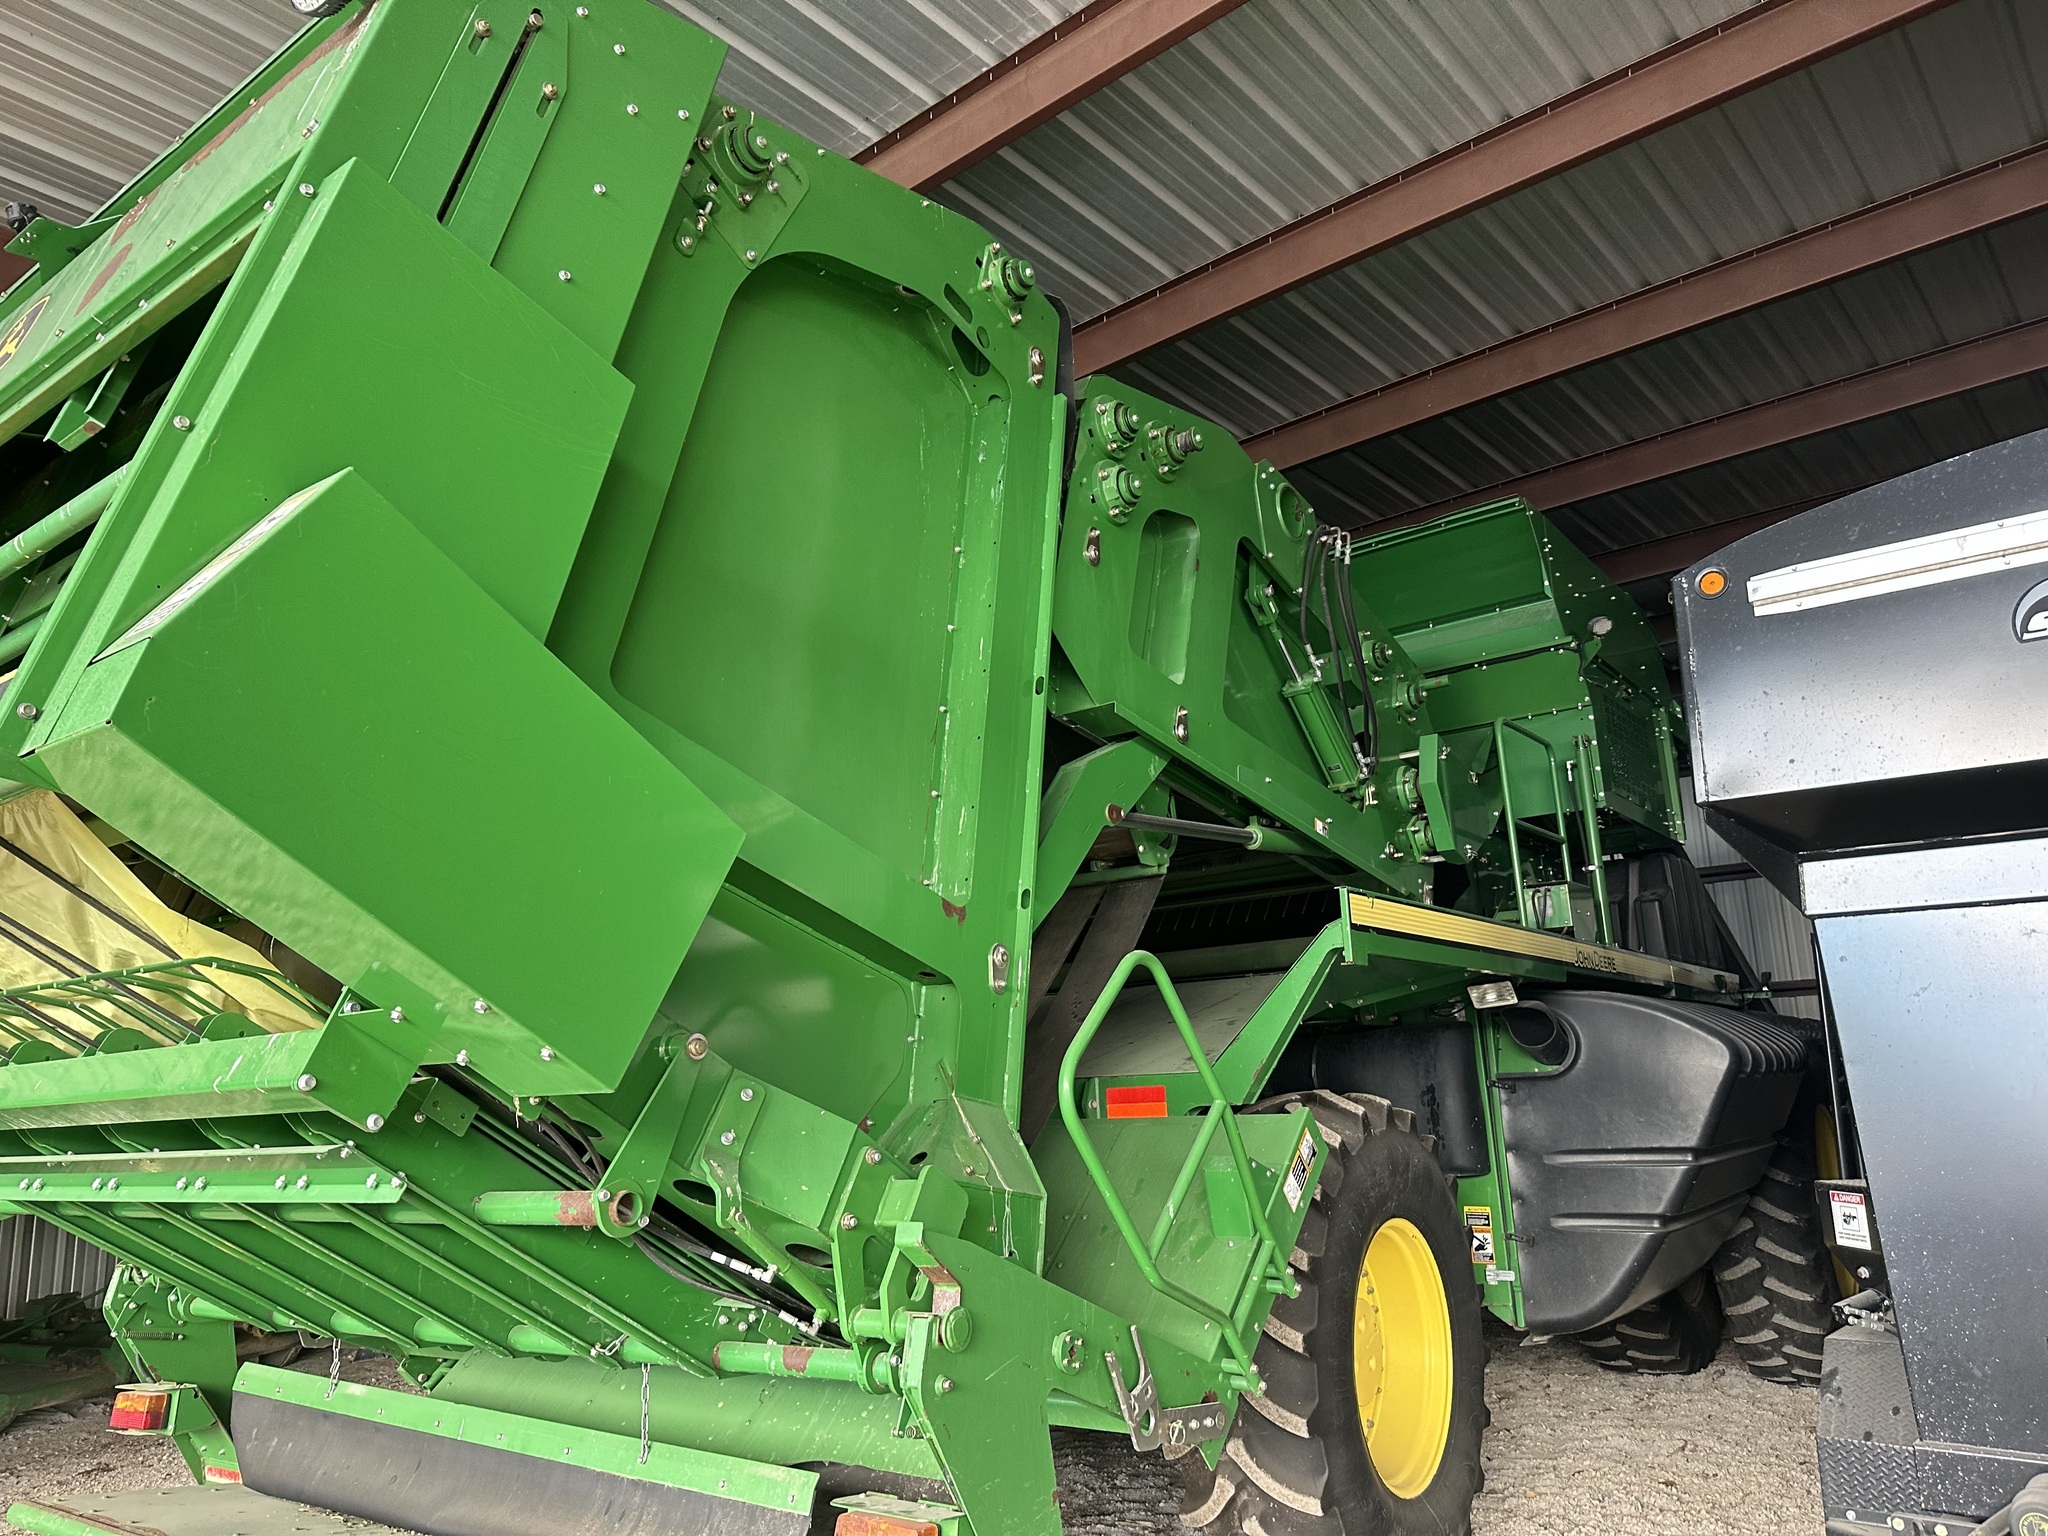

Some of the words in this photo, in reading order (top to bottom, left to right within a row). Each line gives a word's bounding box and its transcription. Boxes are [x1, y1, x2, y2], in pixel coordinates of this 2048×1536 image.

[1574, 946, 1594, 968] JOHN
[1593, 951, 1617, 972] DEERE
[1839, 1194, 1861, 1204] DANGER
